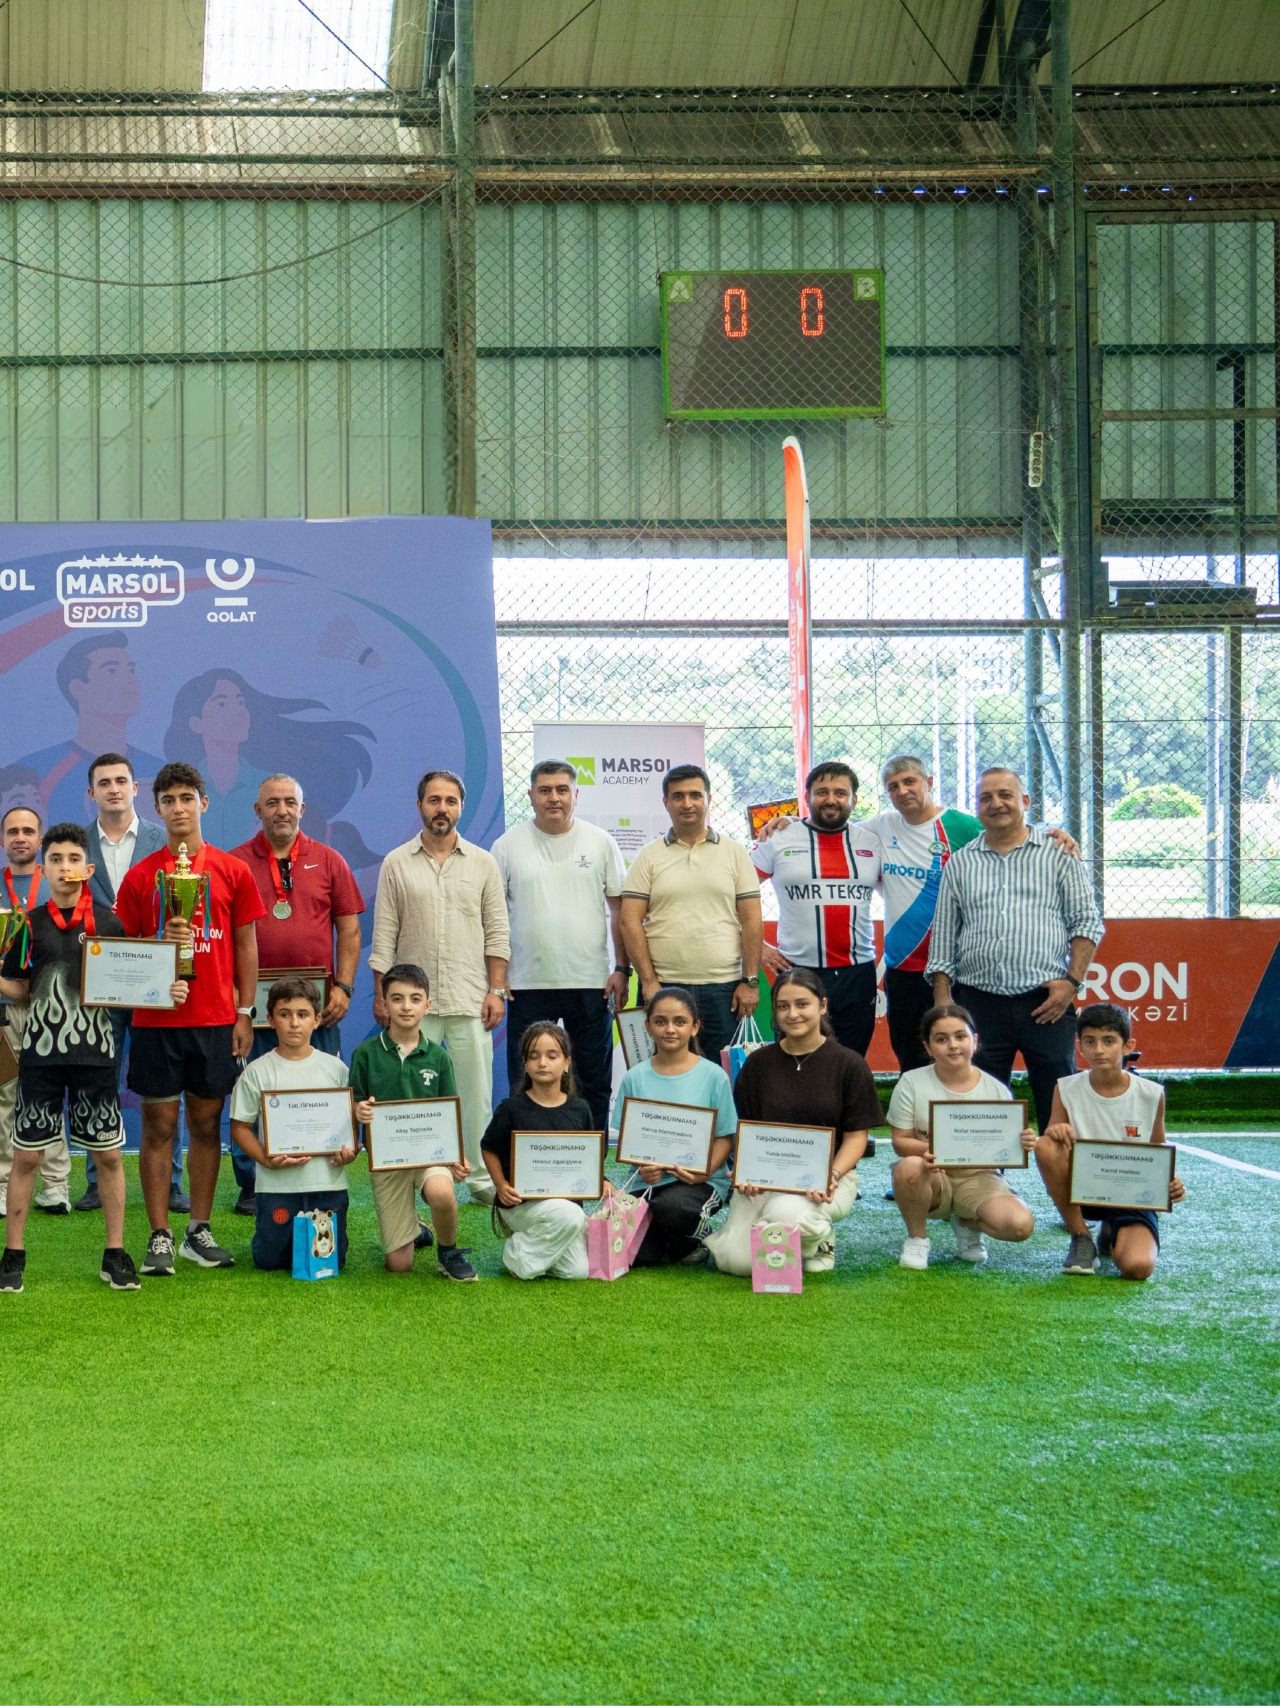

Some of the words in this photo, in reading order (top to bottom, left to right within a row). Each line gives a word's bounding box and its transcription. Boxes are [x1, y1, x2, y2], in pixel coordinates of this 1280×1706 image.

[724, 287, 748, 338] 0
[800, 287, 824, 336] 0
[66, 573, 177, 595] MARSOL
[71, 602, 140, 623] sports
[206, 611, 257, 623] QOLAT
[603, 776, 650, 785] ACADEMY
[785, 884, 822, 900] VMR
[194, 942, 211, 953] UN
[1077, 962, 1188, 1000] RON
[1075, 1002, 1187, 1022] KƏZİ
